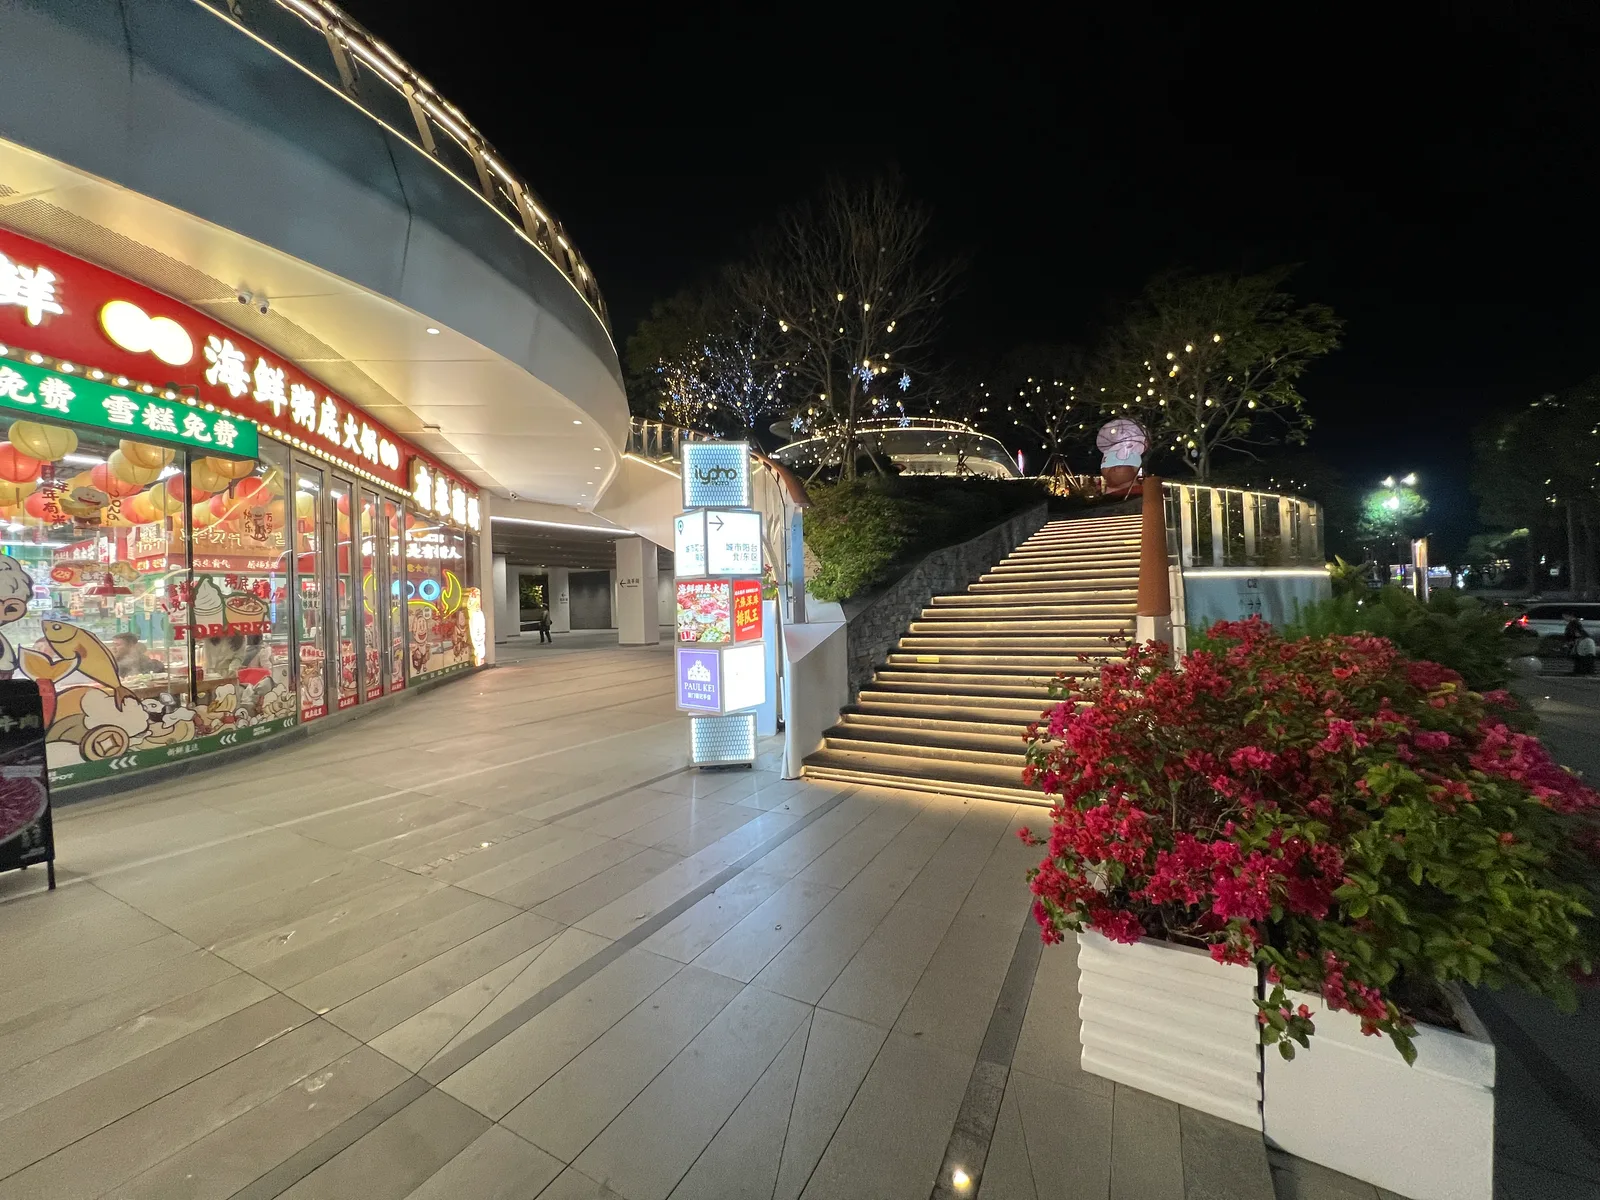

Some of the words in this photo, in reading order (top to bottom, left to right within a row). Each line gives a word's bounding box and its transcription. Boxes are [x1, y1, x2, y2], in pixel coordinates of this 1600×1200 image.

[203, 333, 380, 465] 海鲜粥底火锅
[101, 394, 239, 449] 雪糕免费
[725, 543, 758, 552] 城市阳台
[174, 623, 224, 640] FOR
[226, 620, 272, 637] FREE
[684, 682, 702, 691] PAUL
[703, 683, 715, 692] KEI
